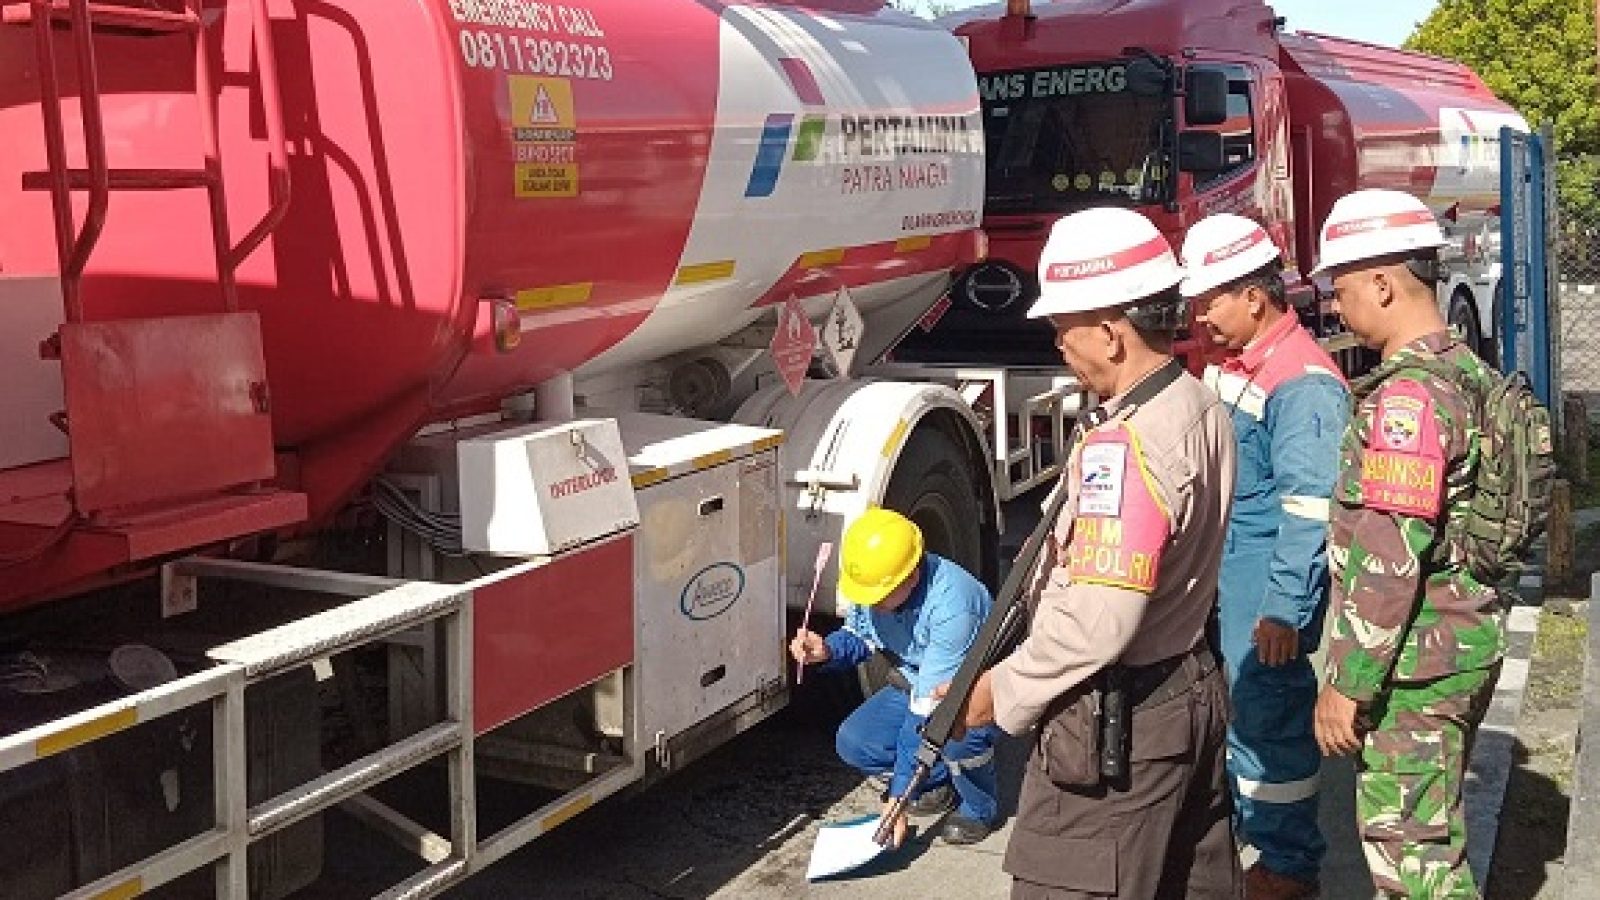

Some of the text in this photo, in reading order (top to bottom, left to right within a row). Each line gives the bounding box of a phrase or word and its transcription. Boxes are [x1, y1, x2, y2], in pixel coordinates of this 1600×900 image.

[447, 0, 604, 37] EMERGENCY CALL
[460, 29, 613, 80] 0811382323
[977, 65, 1128, 101] ANS ENERG
[842, 115, 981, 156] PERTAMINA
[842, 164, 893, 194] PATRA
[1362, 452, 1435, 493] ABINSA
